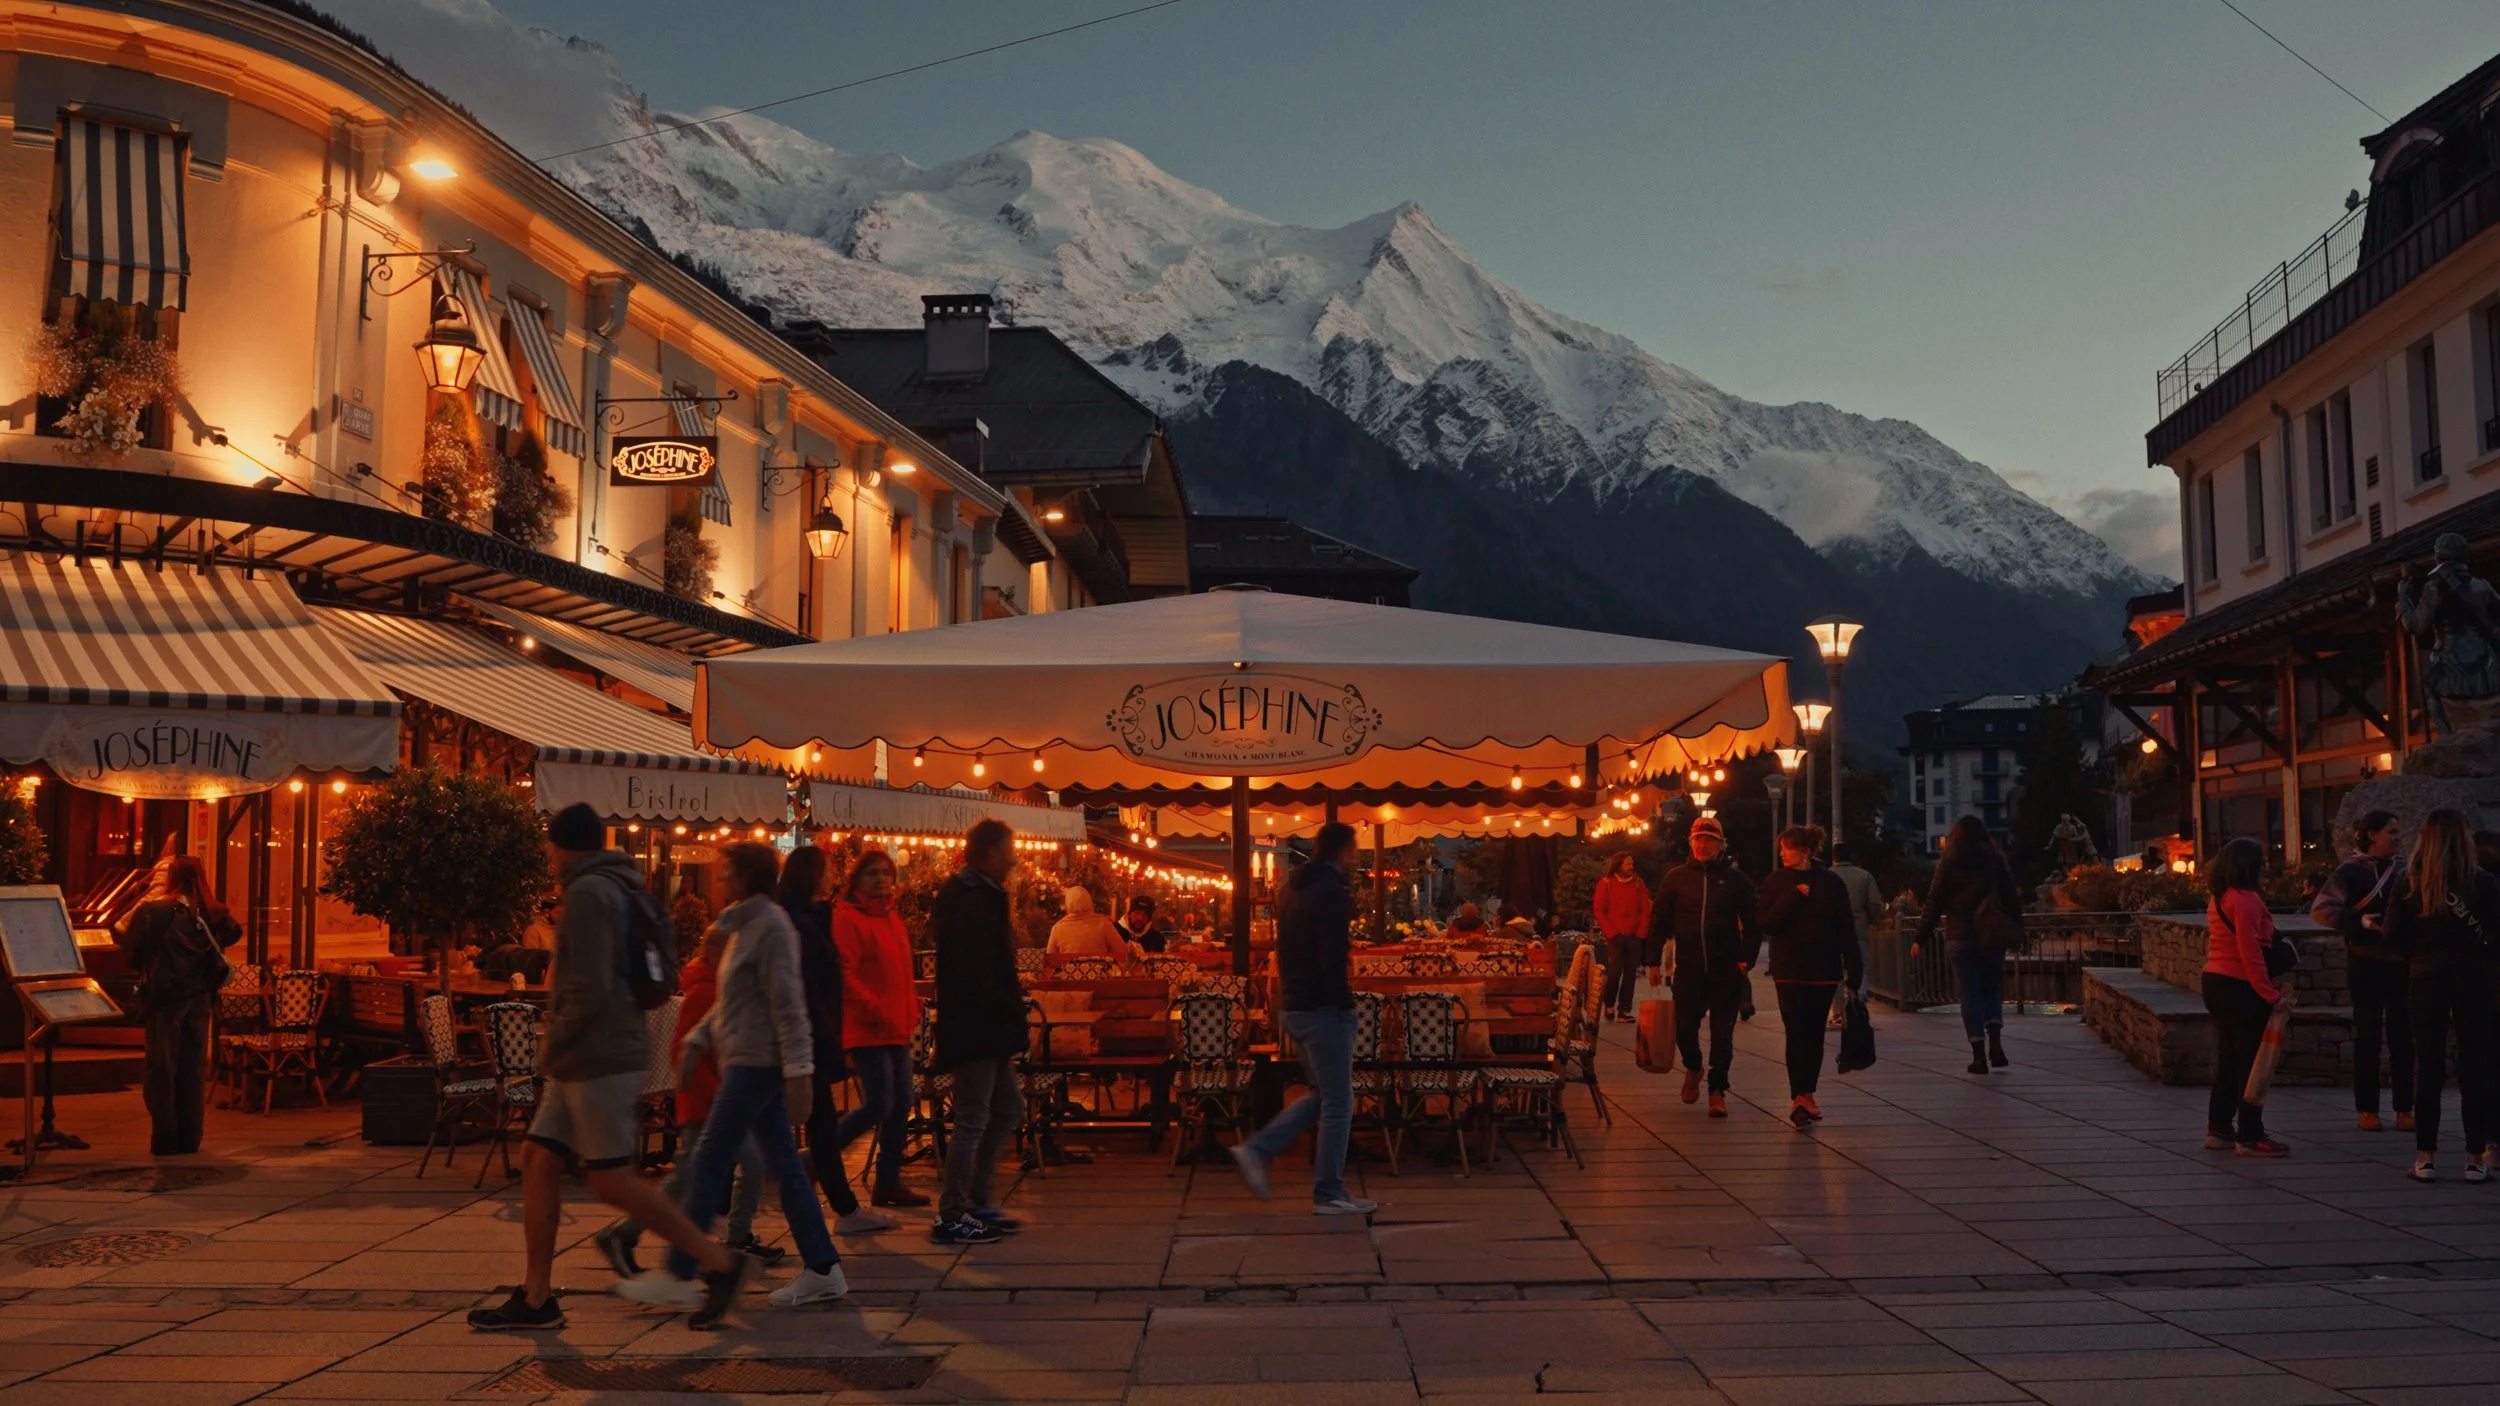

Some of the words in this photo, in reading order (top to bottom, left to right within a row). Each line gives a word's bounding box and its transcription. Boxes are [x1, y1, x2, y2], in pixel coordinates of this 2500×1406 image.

[628, 444, 699, 474] JOSÉPHINE
[1150, 679, 1340, 750] JOSÉPHINE
[88, 719, 262, 780] JOSÉPHINE
[1185, 751, 1239, 761] CHAMONIX
[628, 775, 709, 811] Bistrot
